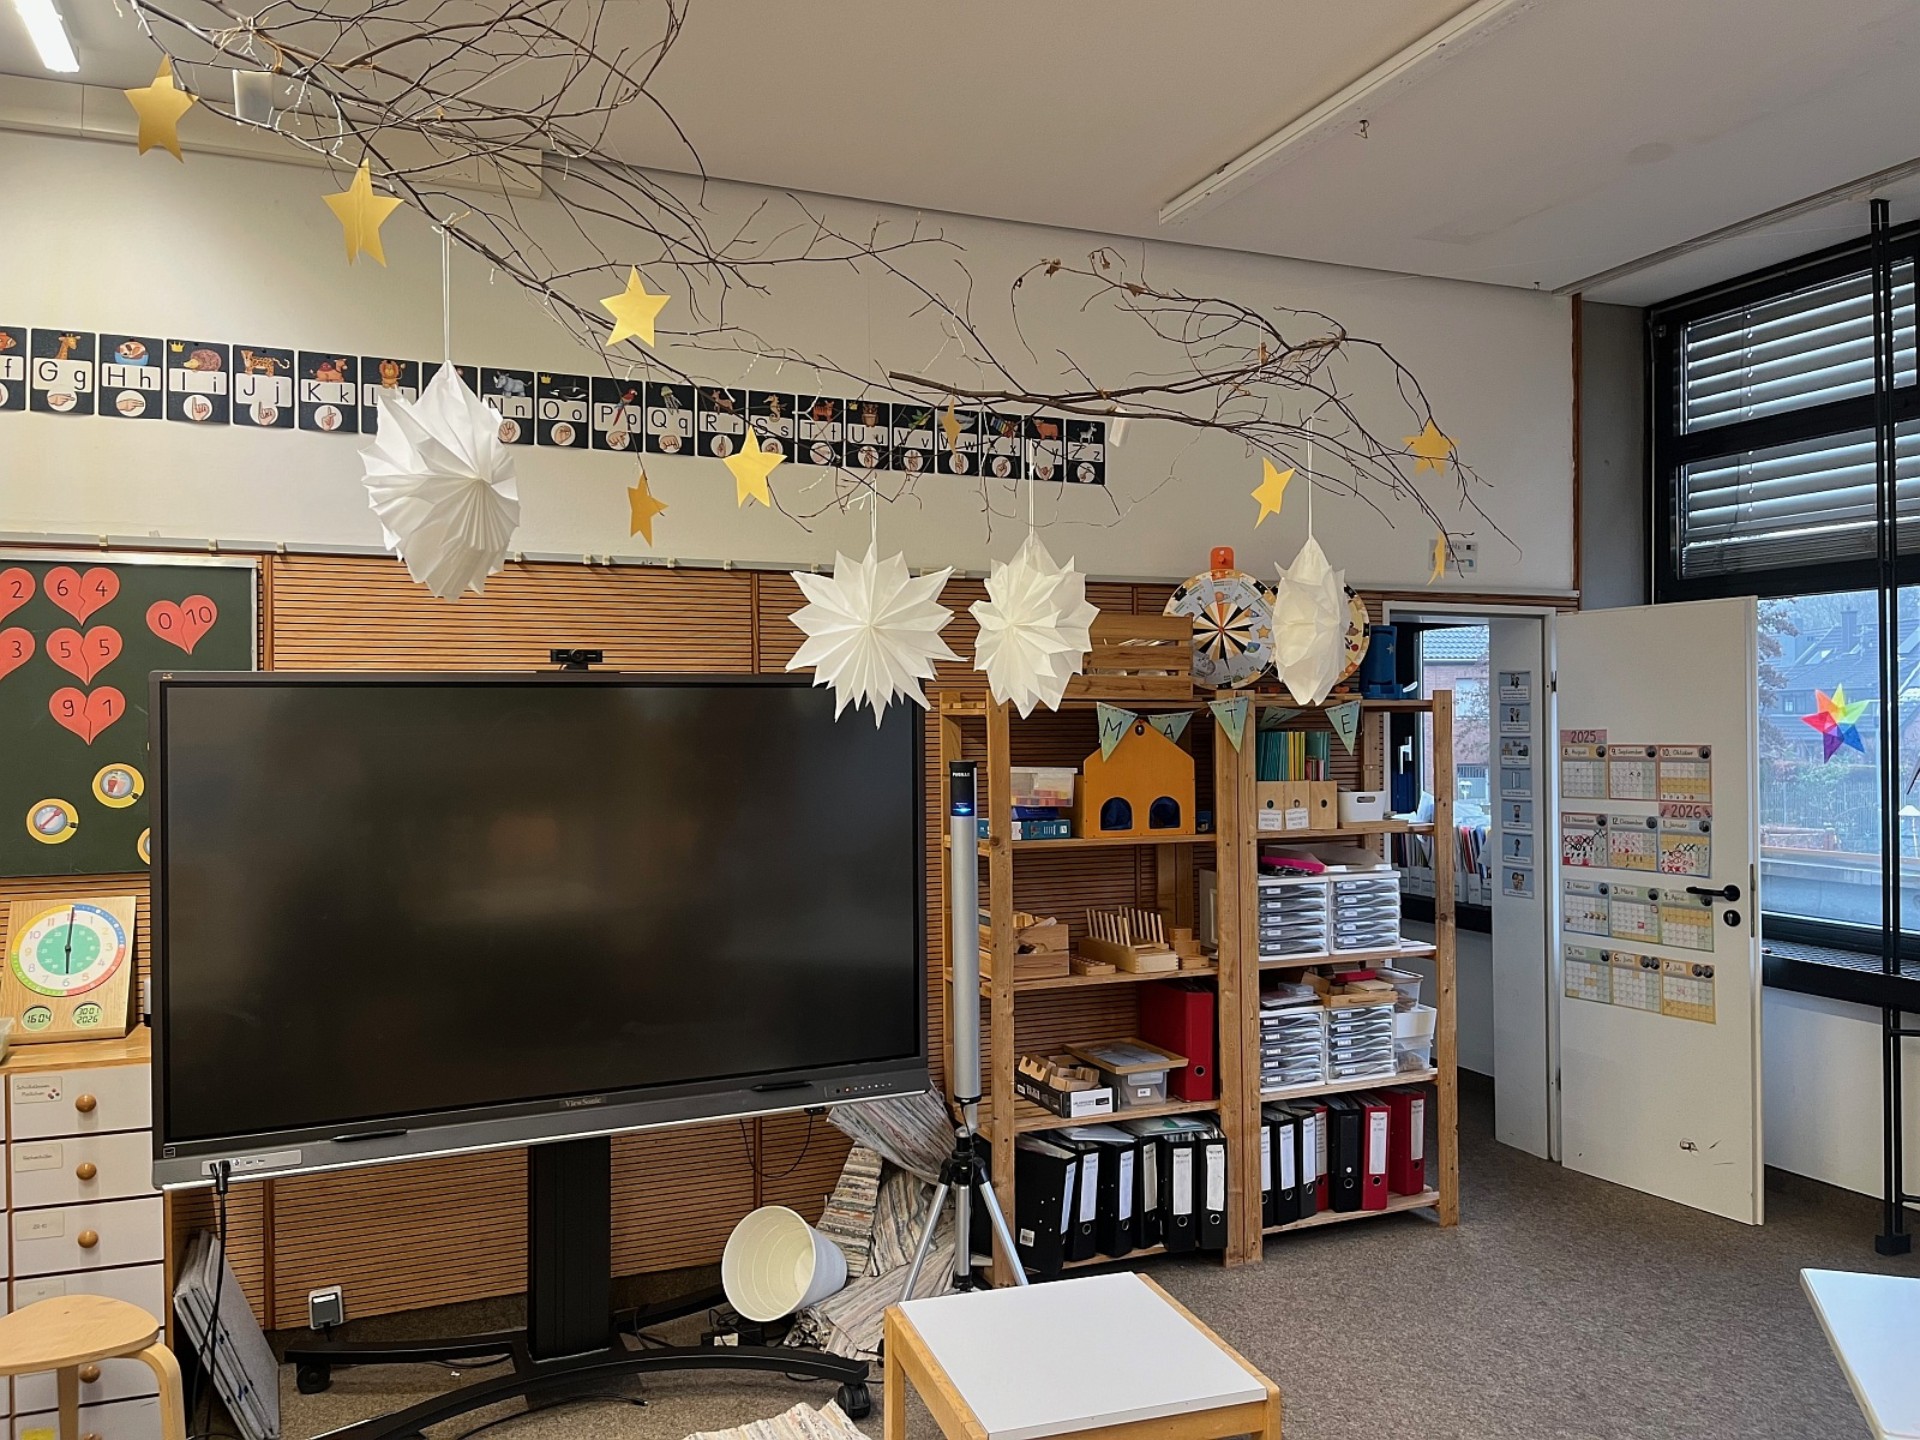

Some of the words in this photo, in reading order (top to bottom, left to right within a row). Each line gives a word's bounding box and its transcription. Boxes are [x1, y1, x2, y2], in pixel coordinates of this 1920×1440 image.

[10, 580, 24, 598] 2
[57, 579, 68, 596] 6
[95, 580, 108, 597] 4
[158, 612, 172, 629] 0
[185, 606, 213, 625] 10
[11, 640, 22, 658] 3
[60, 641, 72, 658] 5
[99, 638, 110, 656] 5
[62, 700, 75, 717] 9
[102, 699, 112, 717] 1
[1571, 731, 1597, 743] 2025
[1671, 805, 1701, 818] 2026
